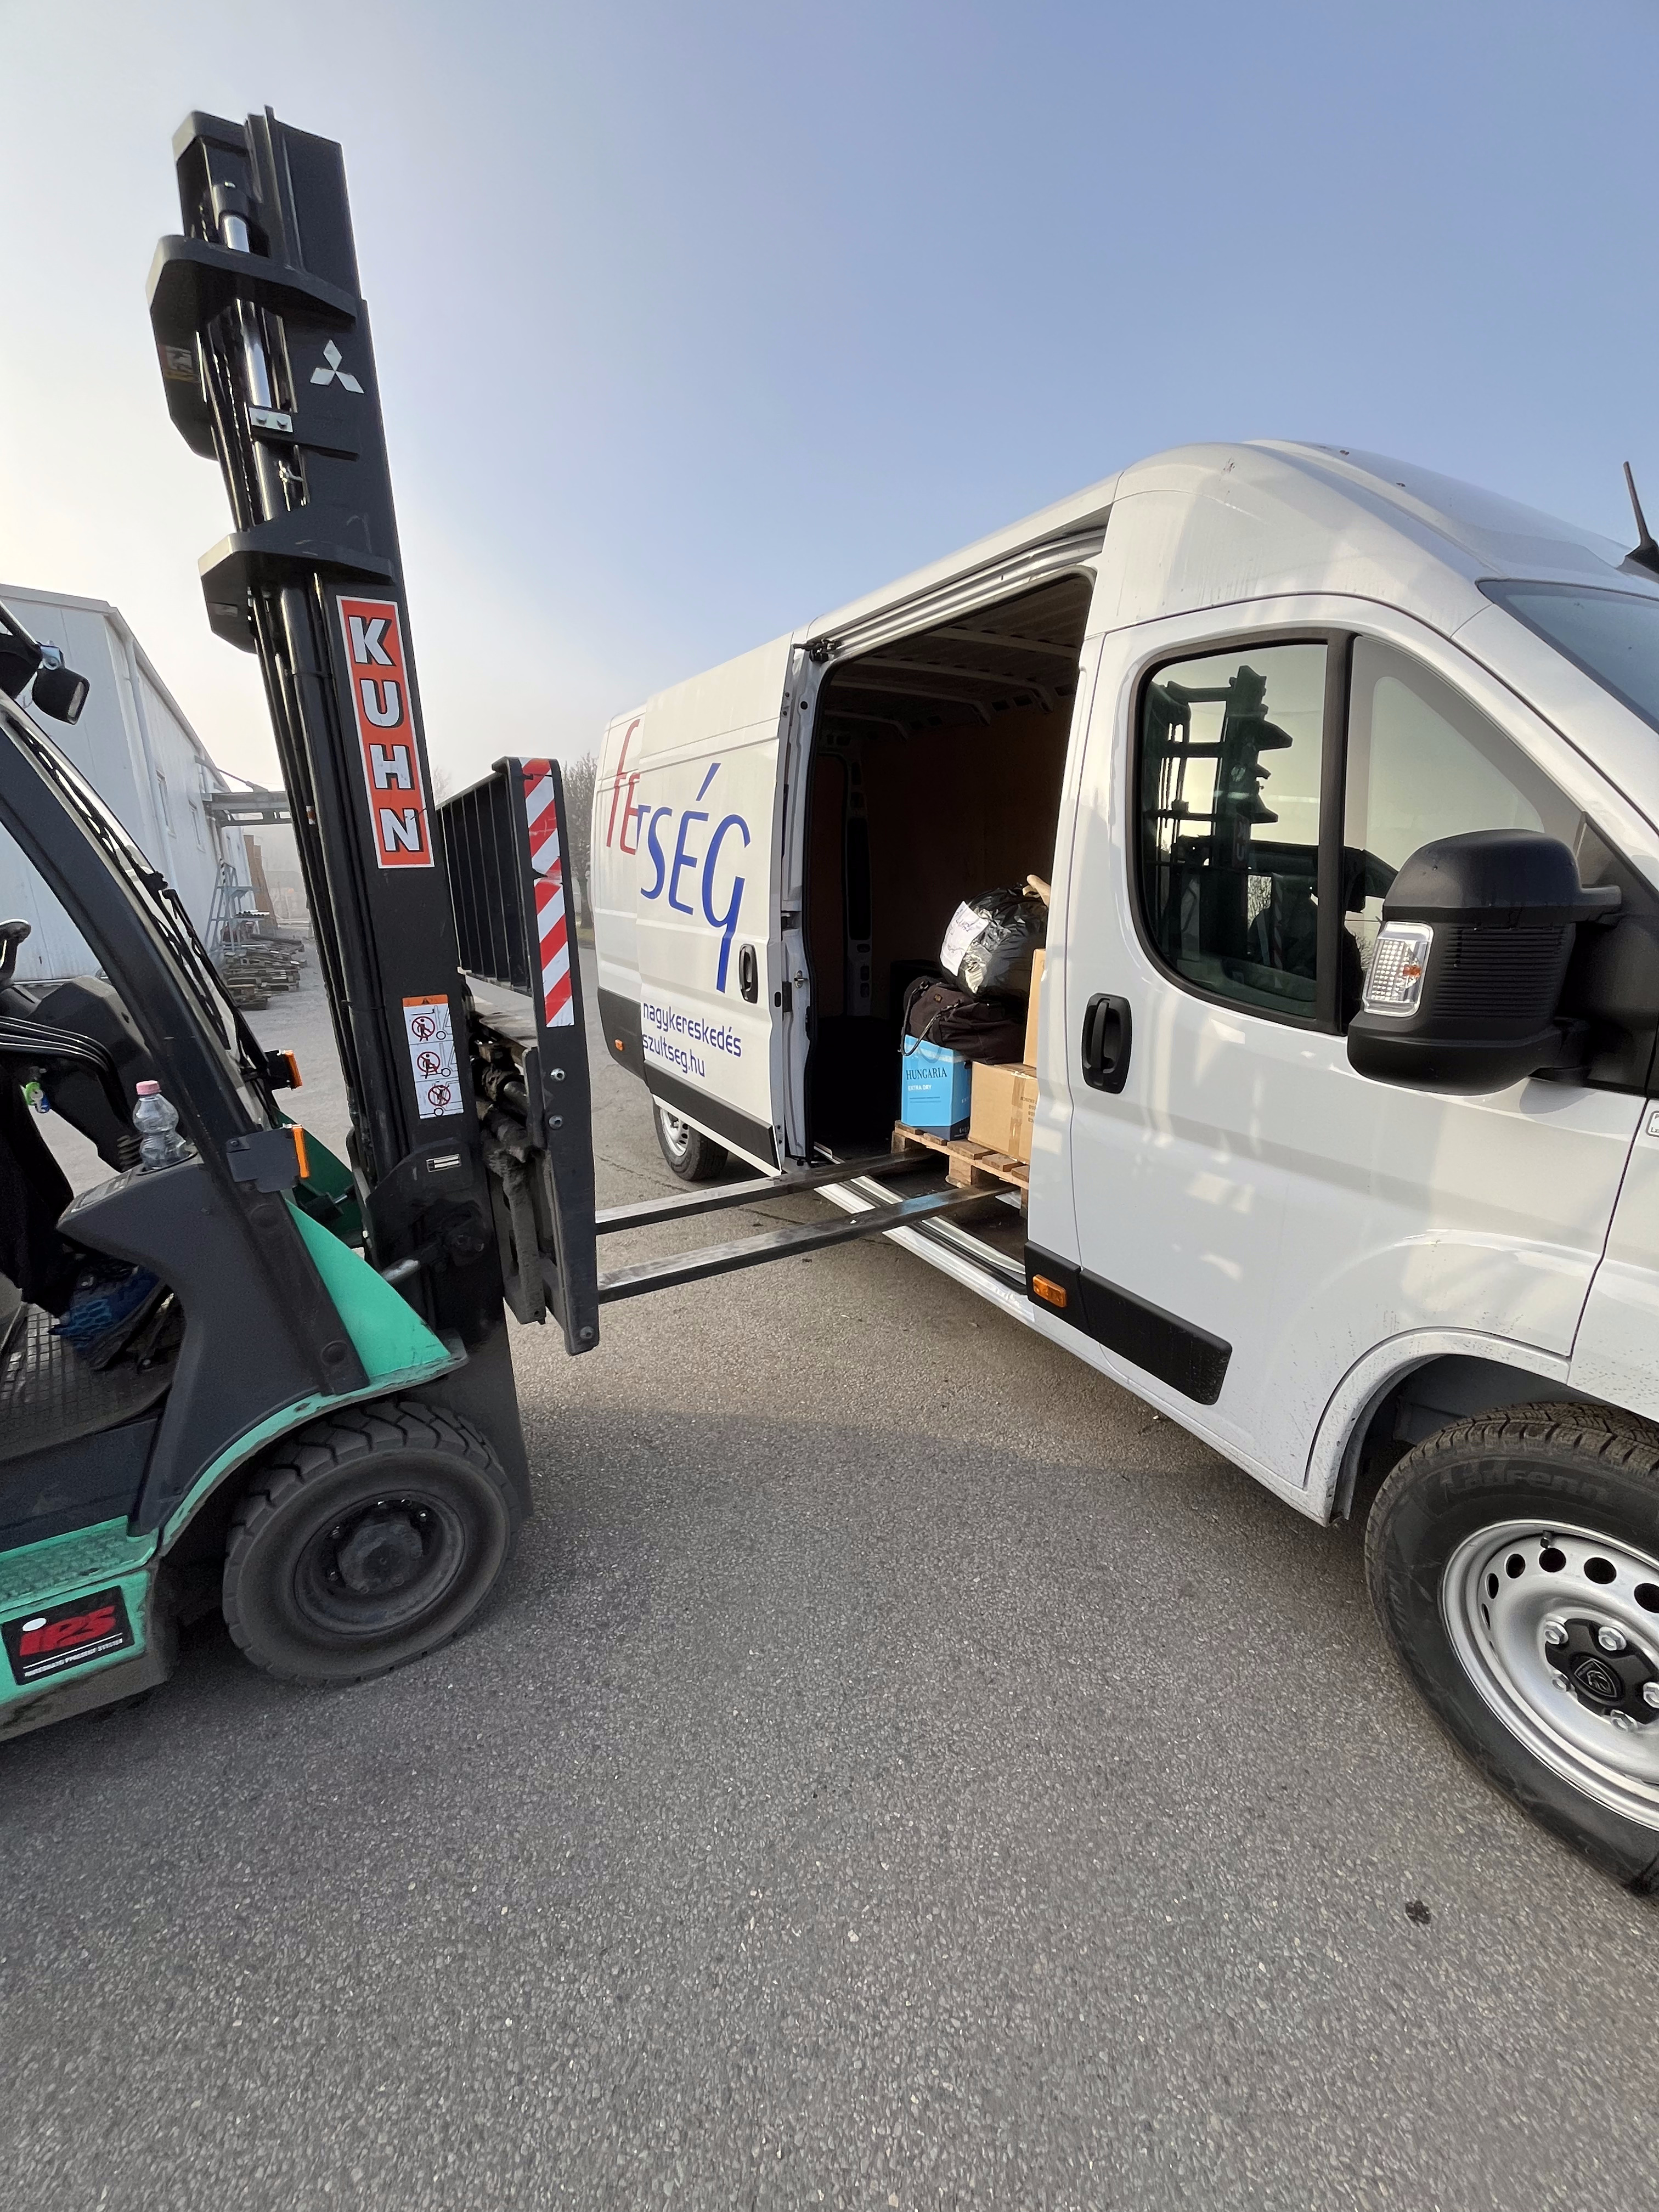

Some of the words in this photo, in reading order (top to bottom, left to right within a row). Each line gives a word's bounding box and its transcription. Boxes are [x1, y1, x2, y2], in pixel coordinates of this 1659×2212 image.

[348, 615, 423, 851] KUHN
[644, 1003, 741, 1057] nagykereskedés
[642, 1034, 706, 1077] szultseg.hu
[906, 1067, 947, 1080] HUNGARIA
